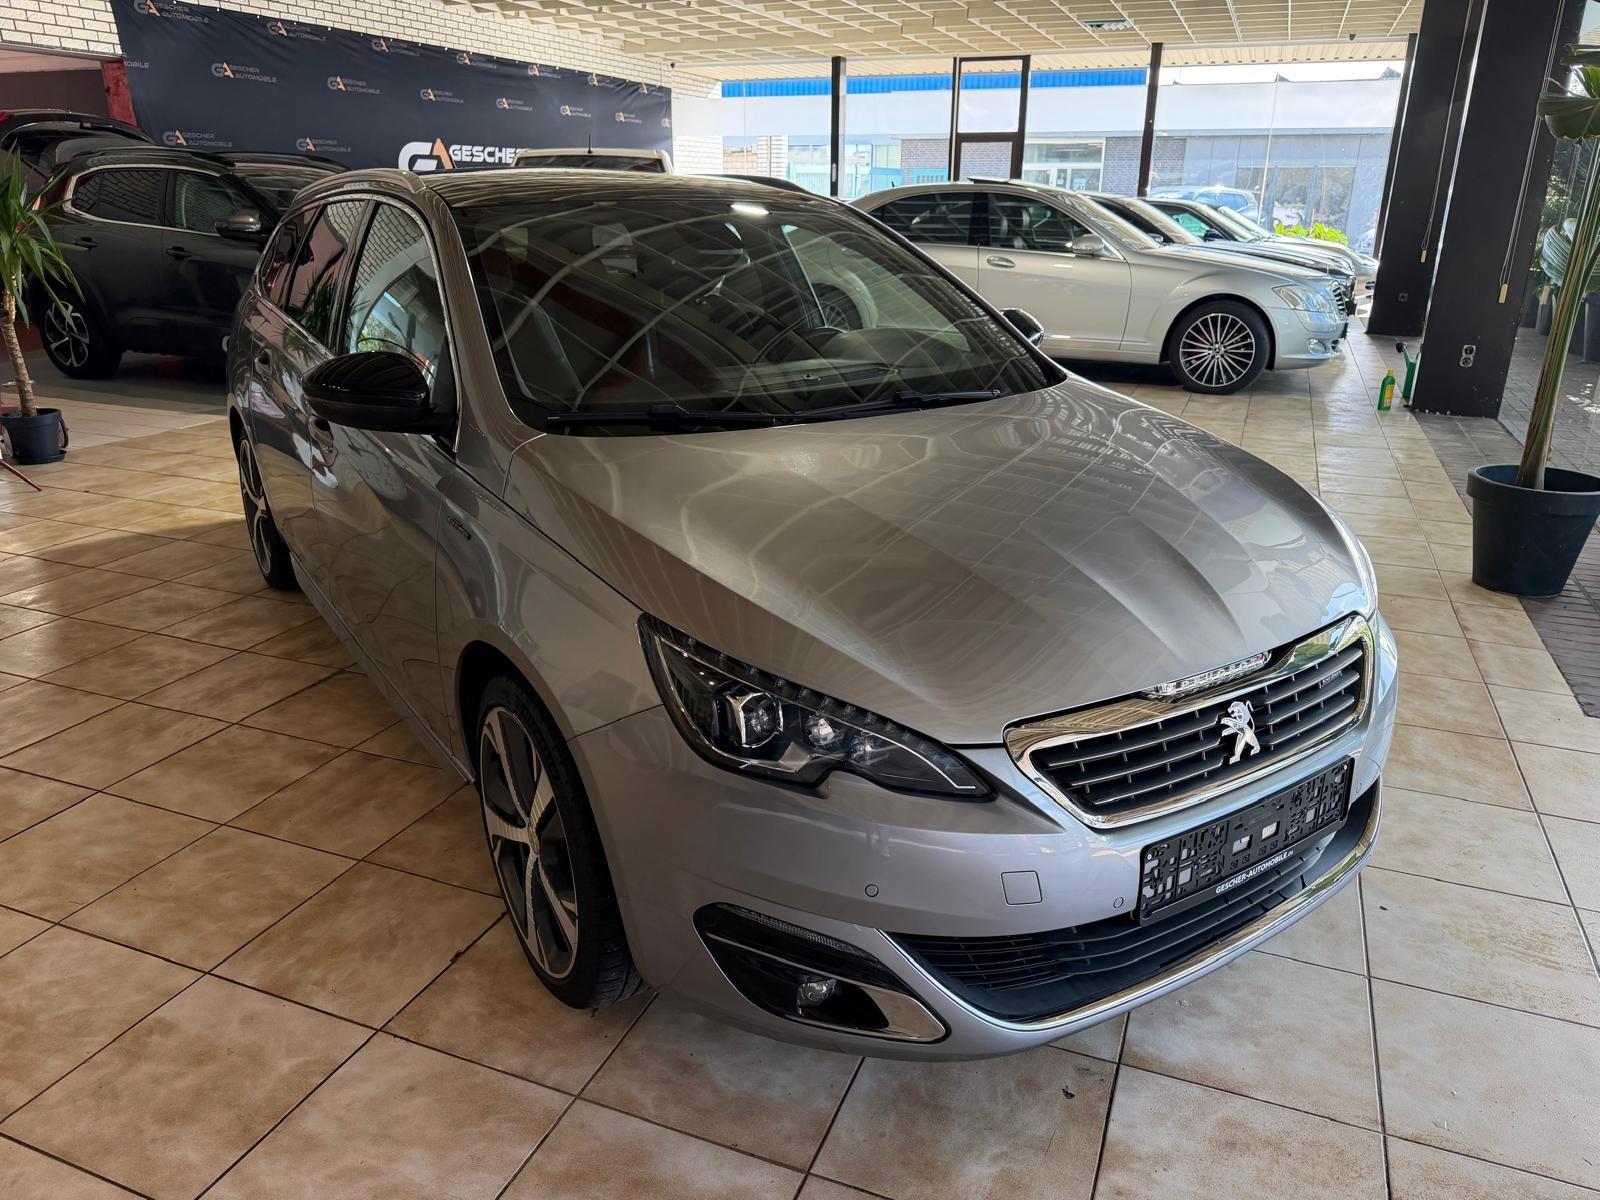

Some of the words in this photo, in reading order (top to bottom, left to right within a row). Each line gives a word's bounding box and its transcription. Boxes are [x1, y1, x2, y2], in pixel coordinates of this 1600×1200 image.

[162, 10, 209, 23] AUTOMOBILE
[230, 64, 260, 74] GESCHER
[234, 72, 276, 84] AUTOMOBILE
[346, 85, 380, 94] AUTOMOBILE
[184, 131, 215, 140] GESCHER
[187, 140, 233, 148] AUTOMOBILE
[316, 145, 352, 153] AUTOMOBILE
